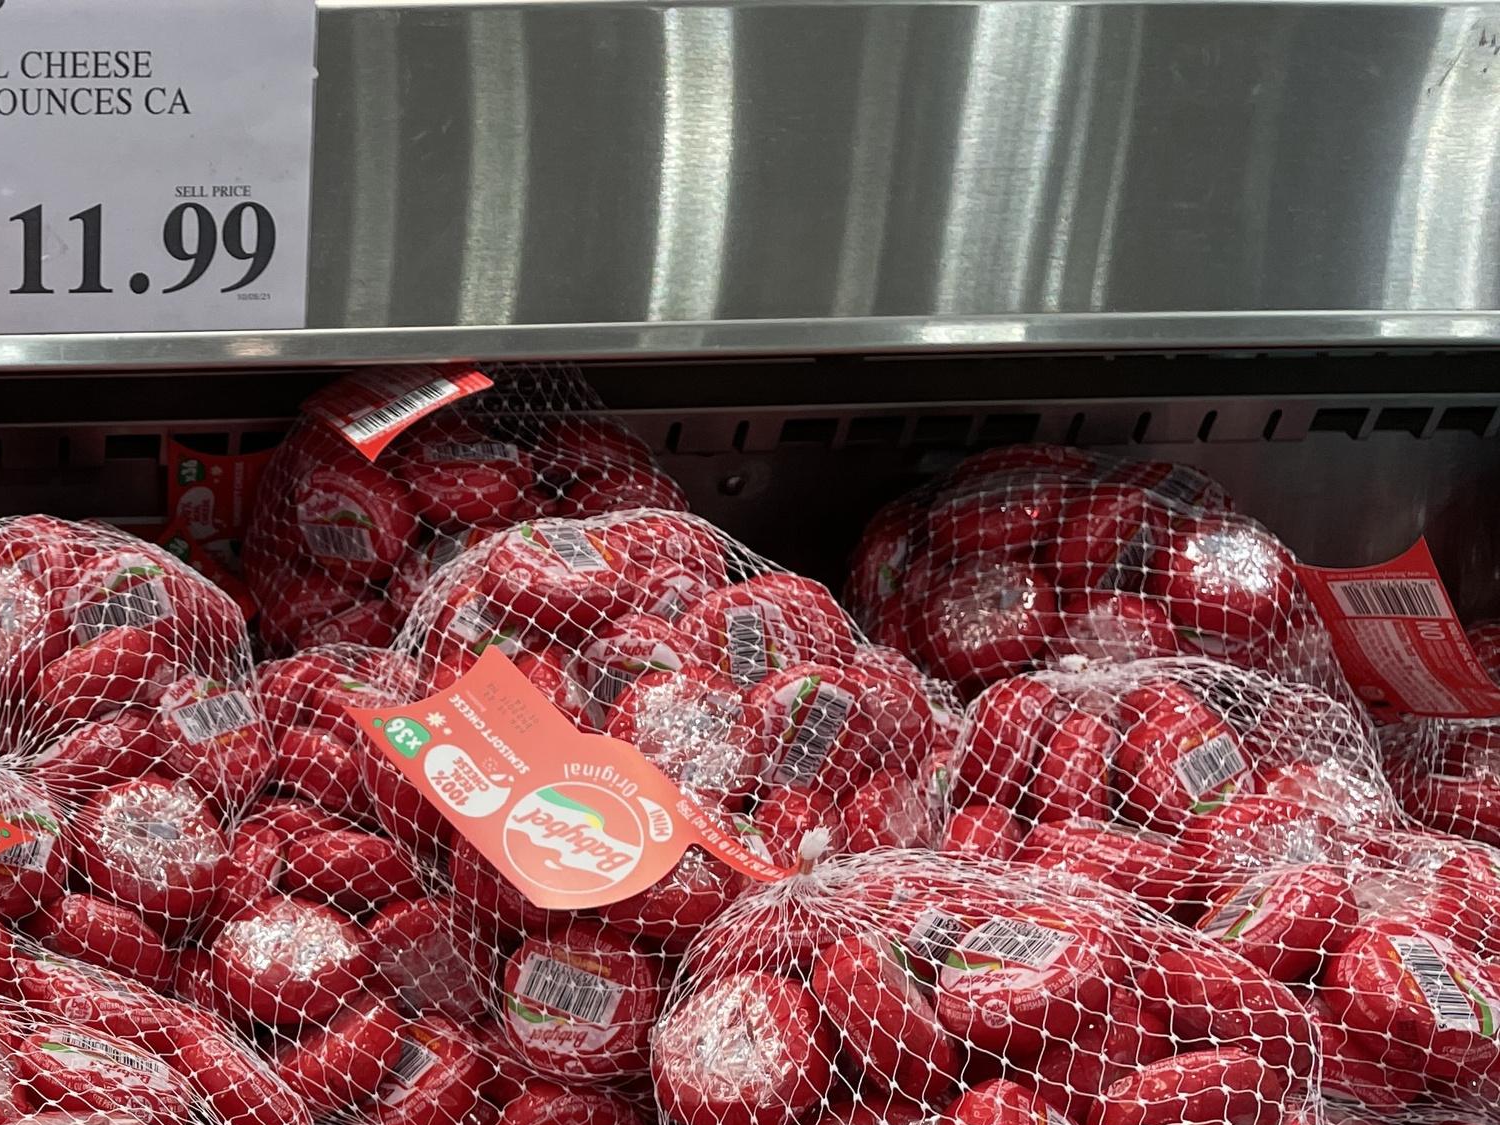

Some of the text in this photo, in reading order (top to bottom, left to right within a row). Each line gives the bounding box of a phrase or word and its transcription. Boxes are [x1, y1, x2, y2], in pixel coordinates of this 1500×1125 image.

[20, 50, 153, 79] CHEESE
[144, 87, 191, 115] CA
[174, 185, 252, 198] SELL PRICE
[8, 201, 276, 294] 11.99
[449, 694, 485, 730] CHEESE
[387, 718, 422, 750] x36
[481, 729, 530, 774] SEMISOFT
[431, 771, 469, 806] 100%
[451, 768, 476, 792] REAL
[452, 757, 489, 792] CHEESE
[563, 762, 639, 797] Original
[513, 807, 634, 872] Babybel
[648, 809, 670, 837] MINI
